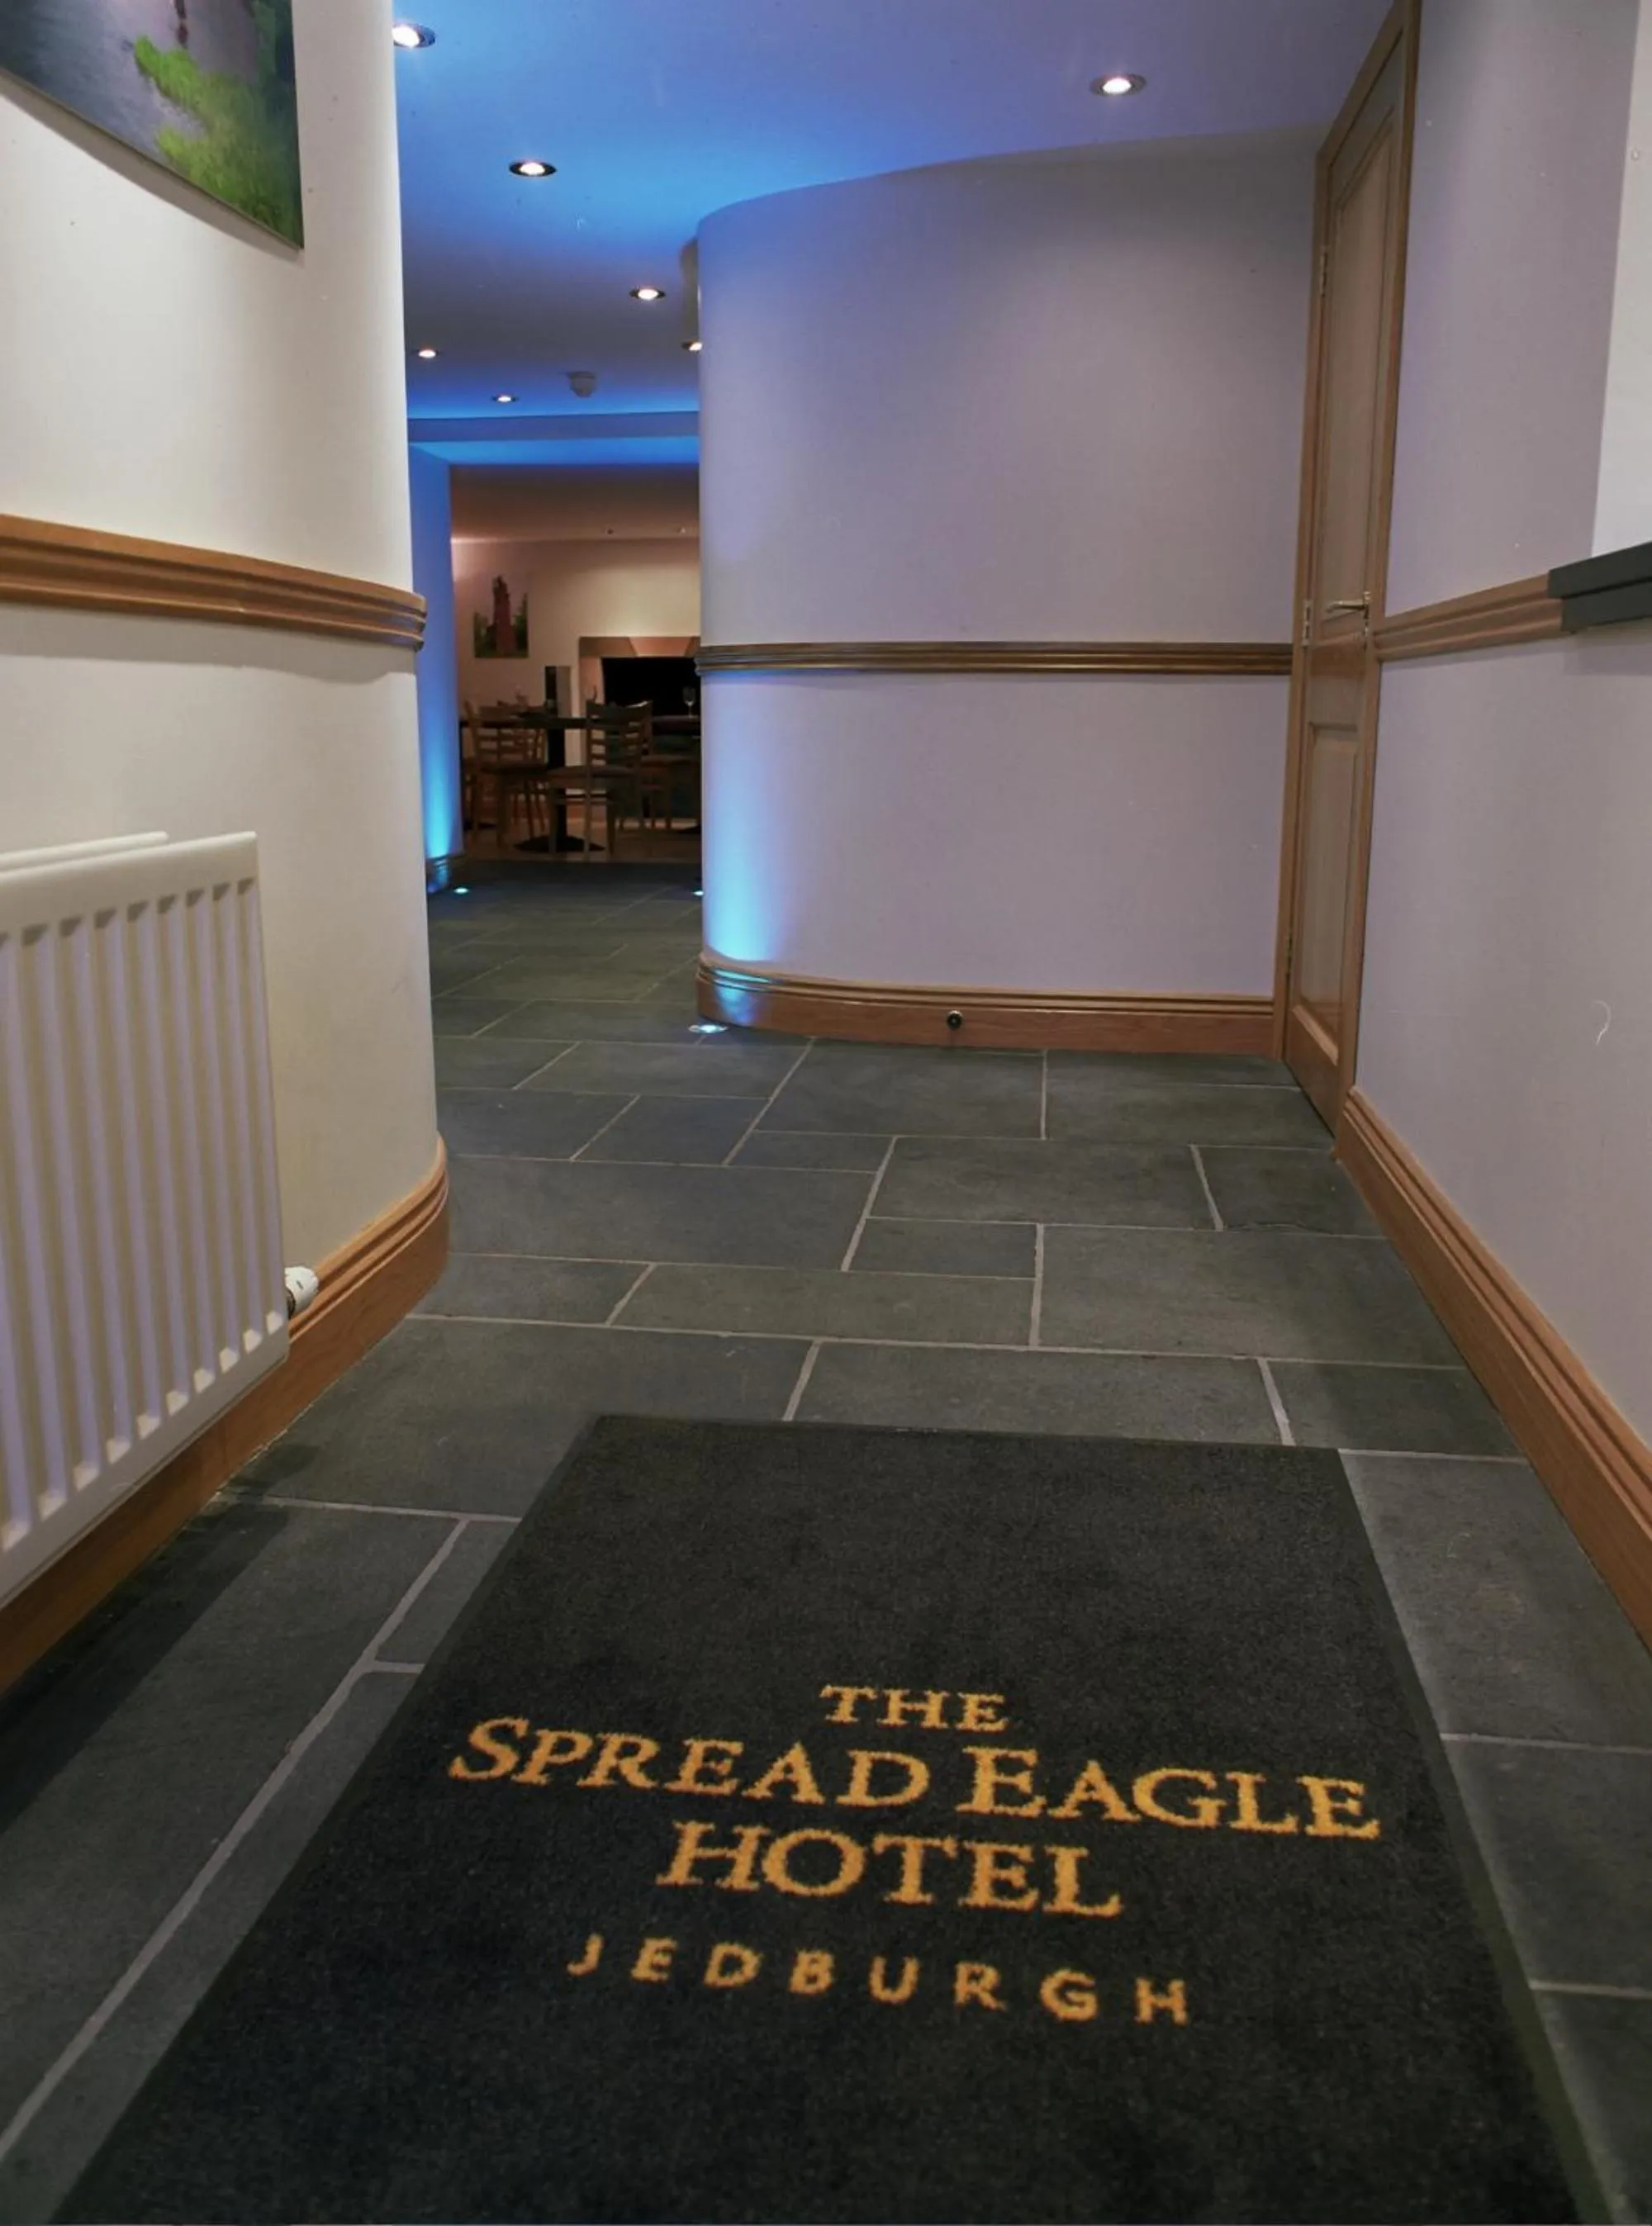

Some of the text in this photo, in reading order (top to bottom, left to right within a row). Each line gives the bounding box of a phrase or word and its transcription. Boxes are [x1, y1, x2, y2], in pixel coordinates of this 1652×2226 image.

[820, 1685, 1007, 1733] THE
[449, 1717, 1381, 1840] SPREAD EAGLE
[656, 1820, 1123, 1918] HOTEL
[567, 1934, 1188, 2024] JEDBURGH
